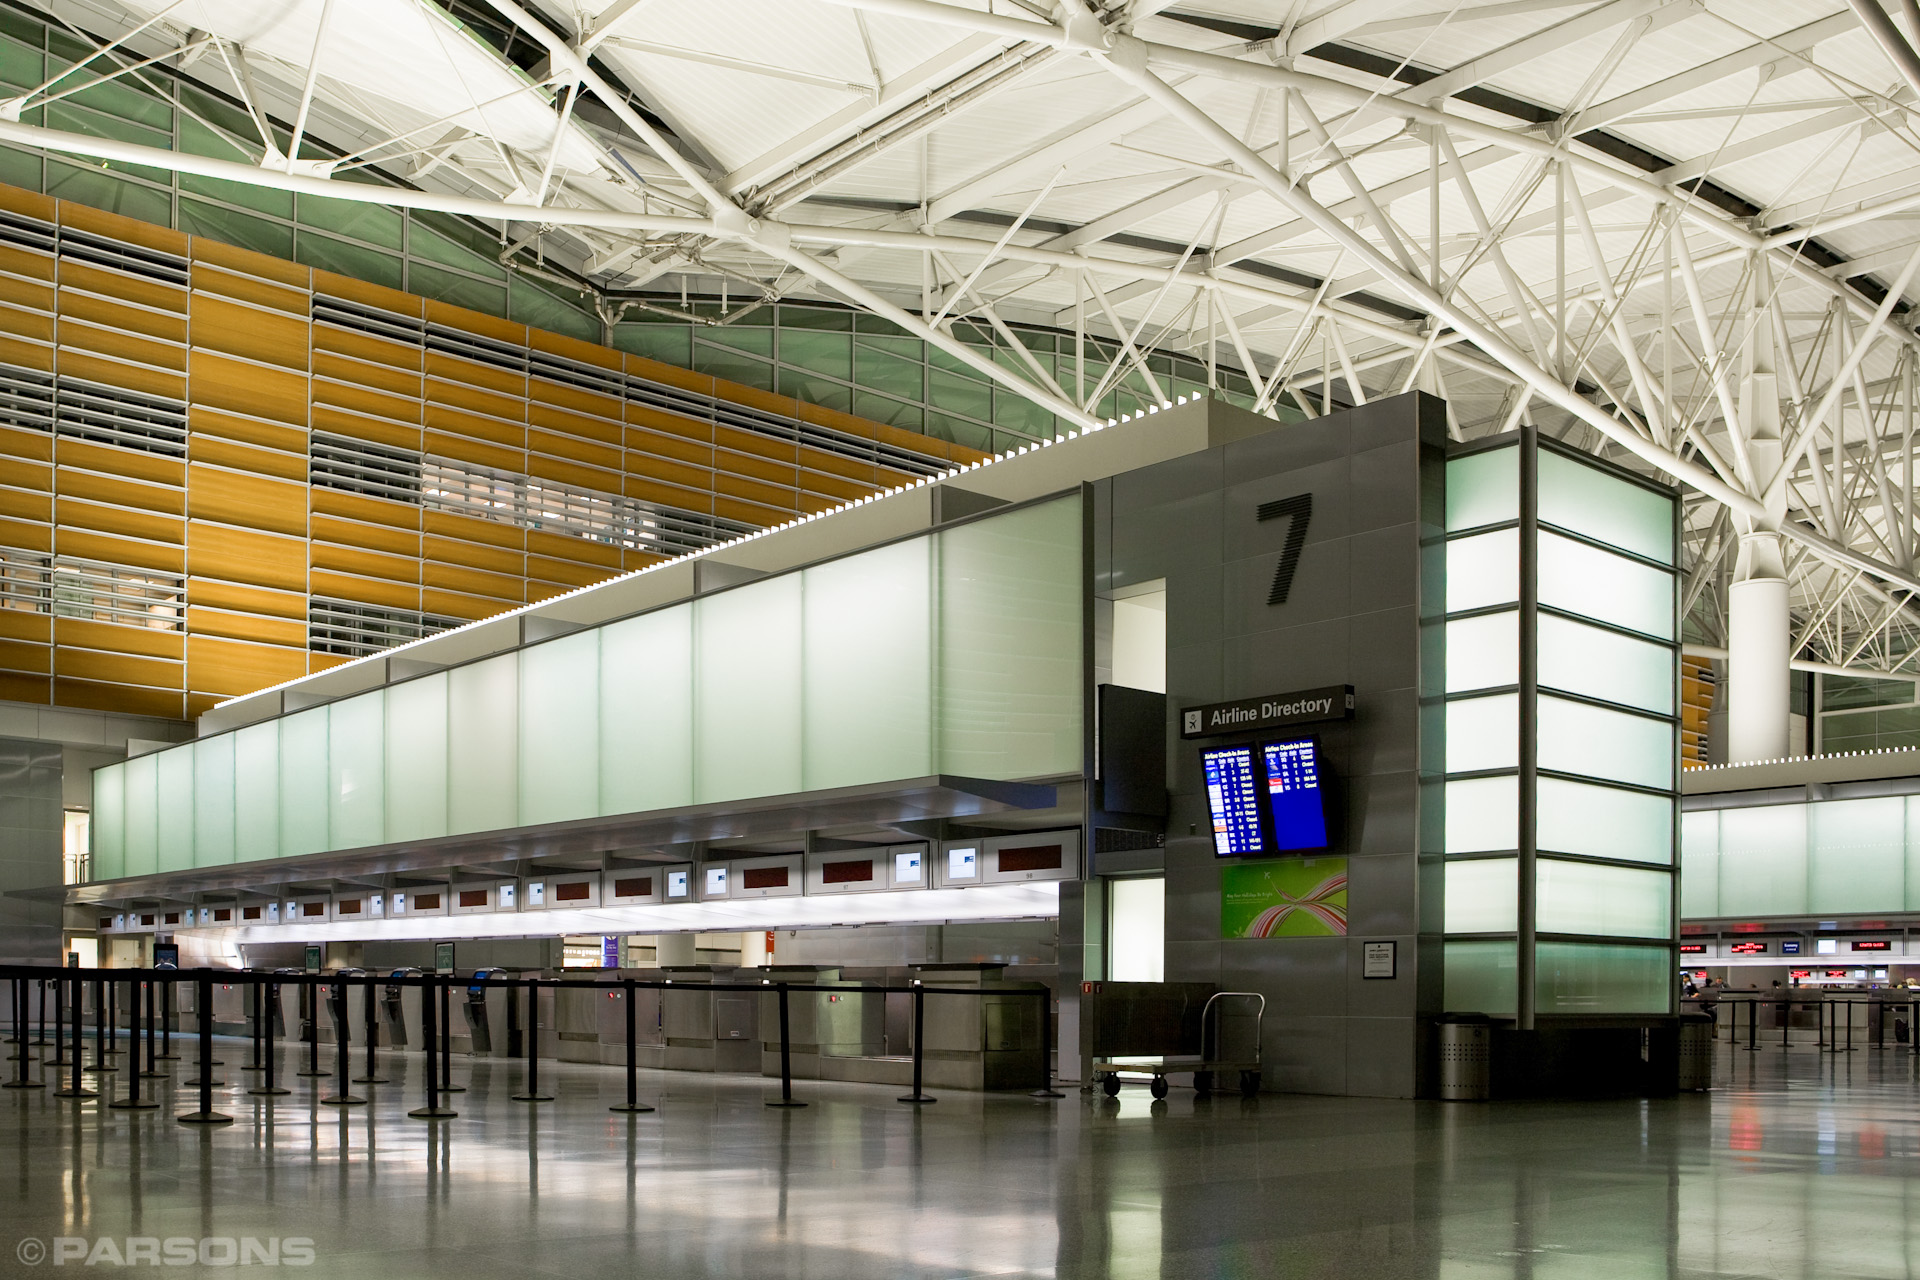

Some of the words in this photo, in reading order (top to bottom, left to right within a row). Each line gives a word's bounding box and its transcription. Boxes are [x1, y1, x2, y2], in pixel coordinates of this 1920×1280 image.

[1256, 492, 1312, 606] 7
[1210, 707, 1258, 726] Airline
[1261, 698, 1333, 719] Directory
